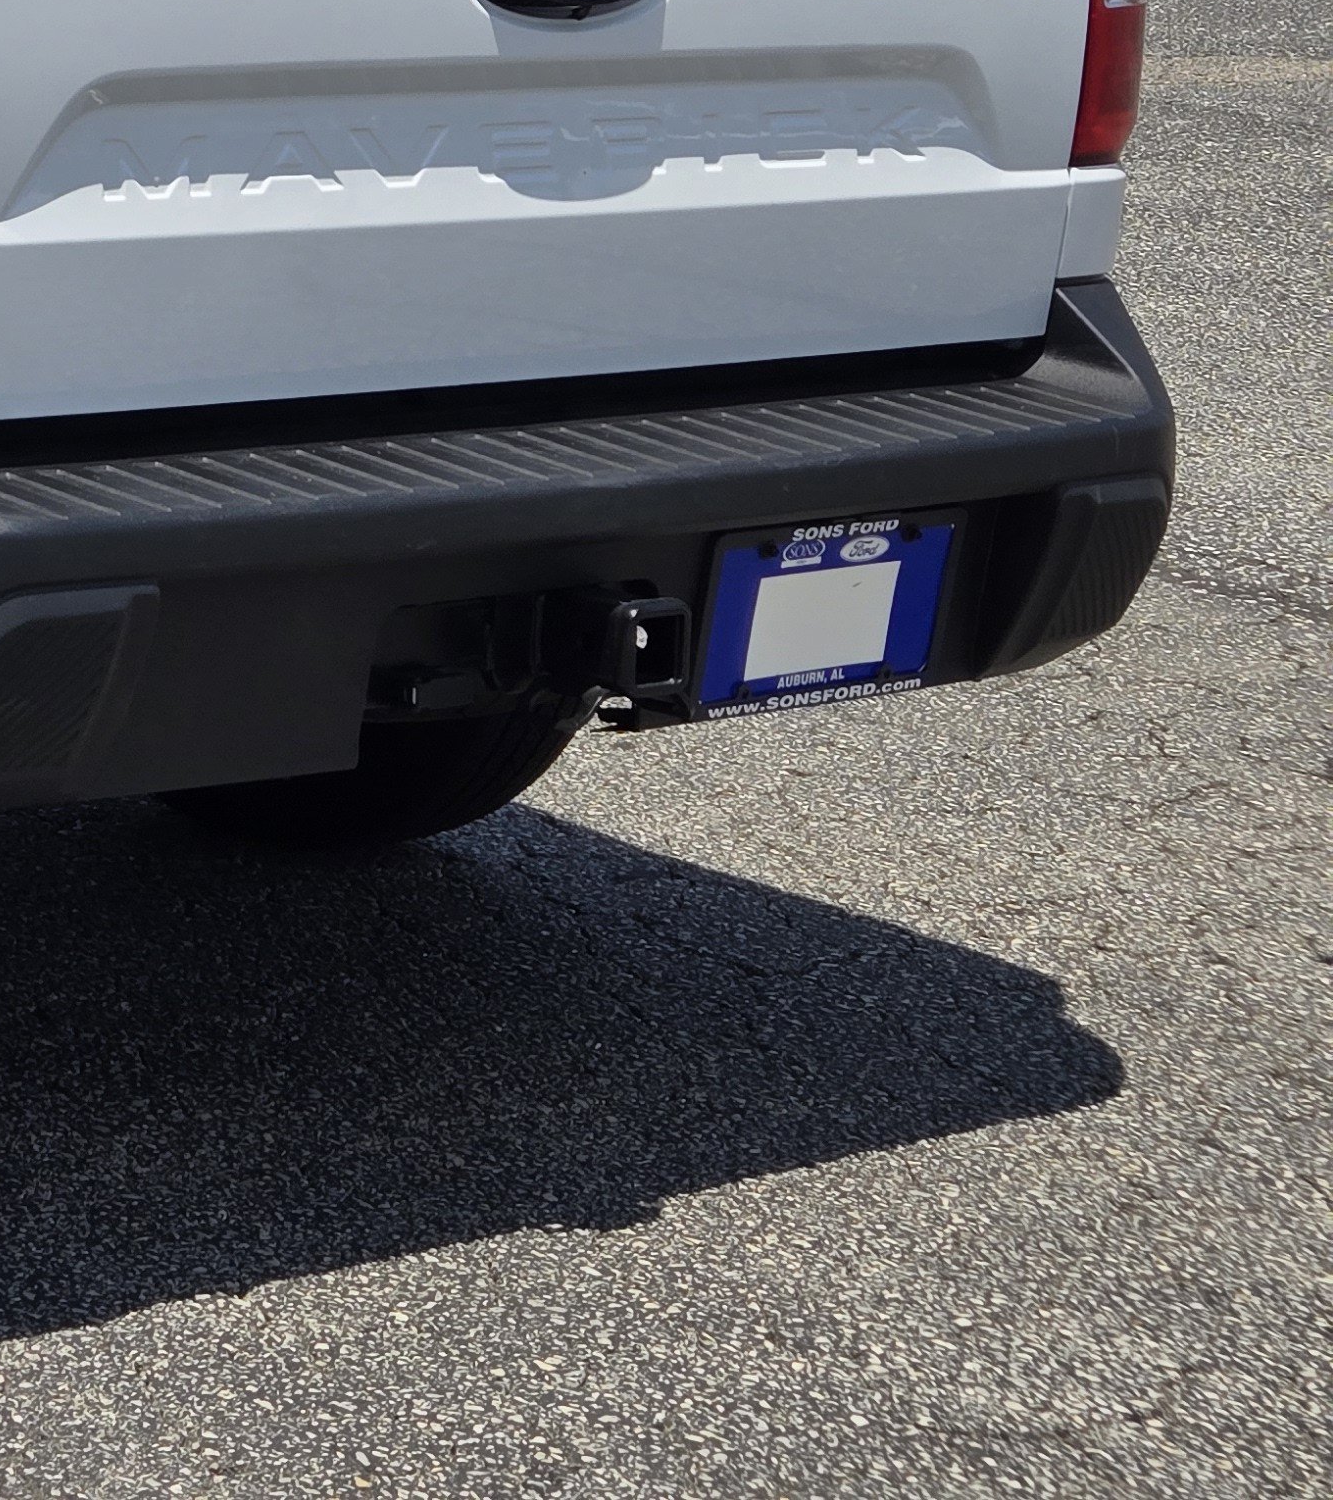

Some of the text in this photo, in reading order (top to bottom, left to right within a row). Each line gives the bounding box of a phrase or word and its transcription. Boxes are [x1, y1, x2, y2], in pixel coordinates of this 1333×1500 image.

[101, 104, 926, 202] MAVERICK
[792, 519, 900, 542] SONS FORD
[848, 540, 880, 558] Ford
[776, 668, 845, 689] AUBURN, AL
[707, 676, 922, 719] www.SONSFORD.com
